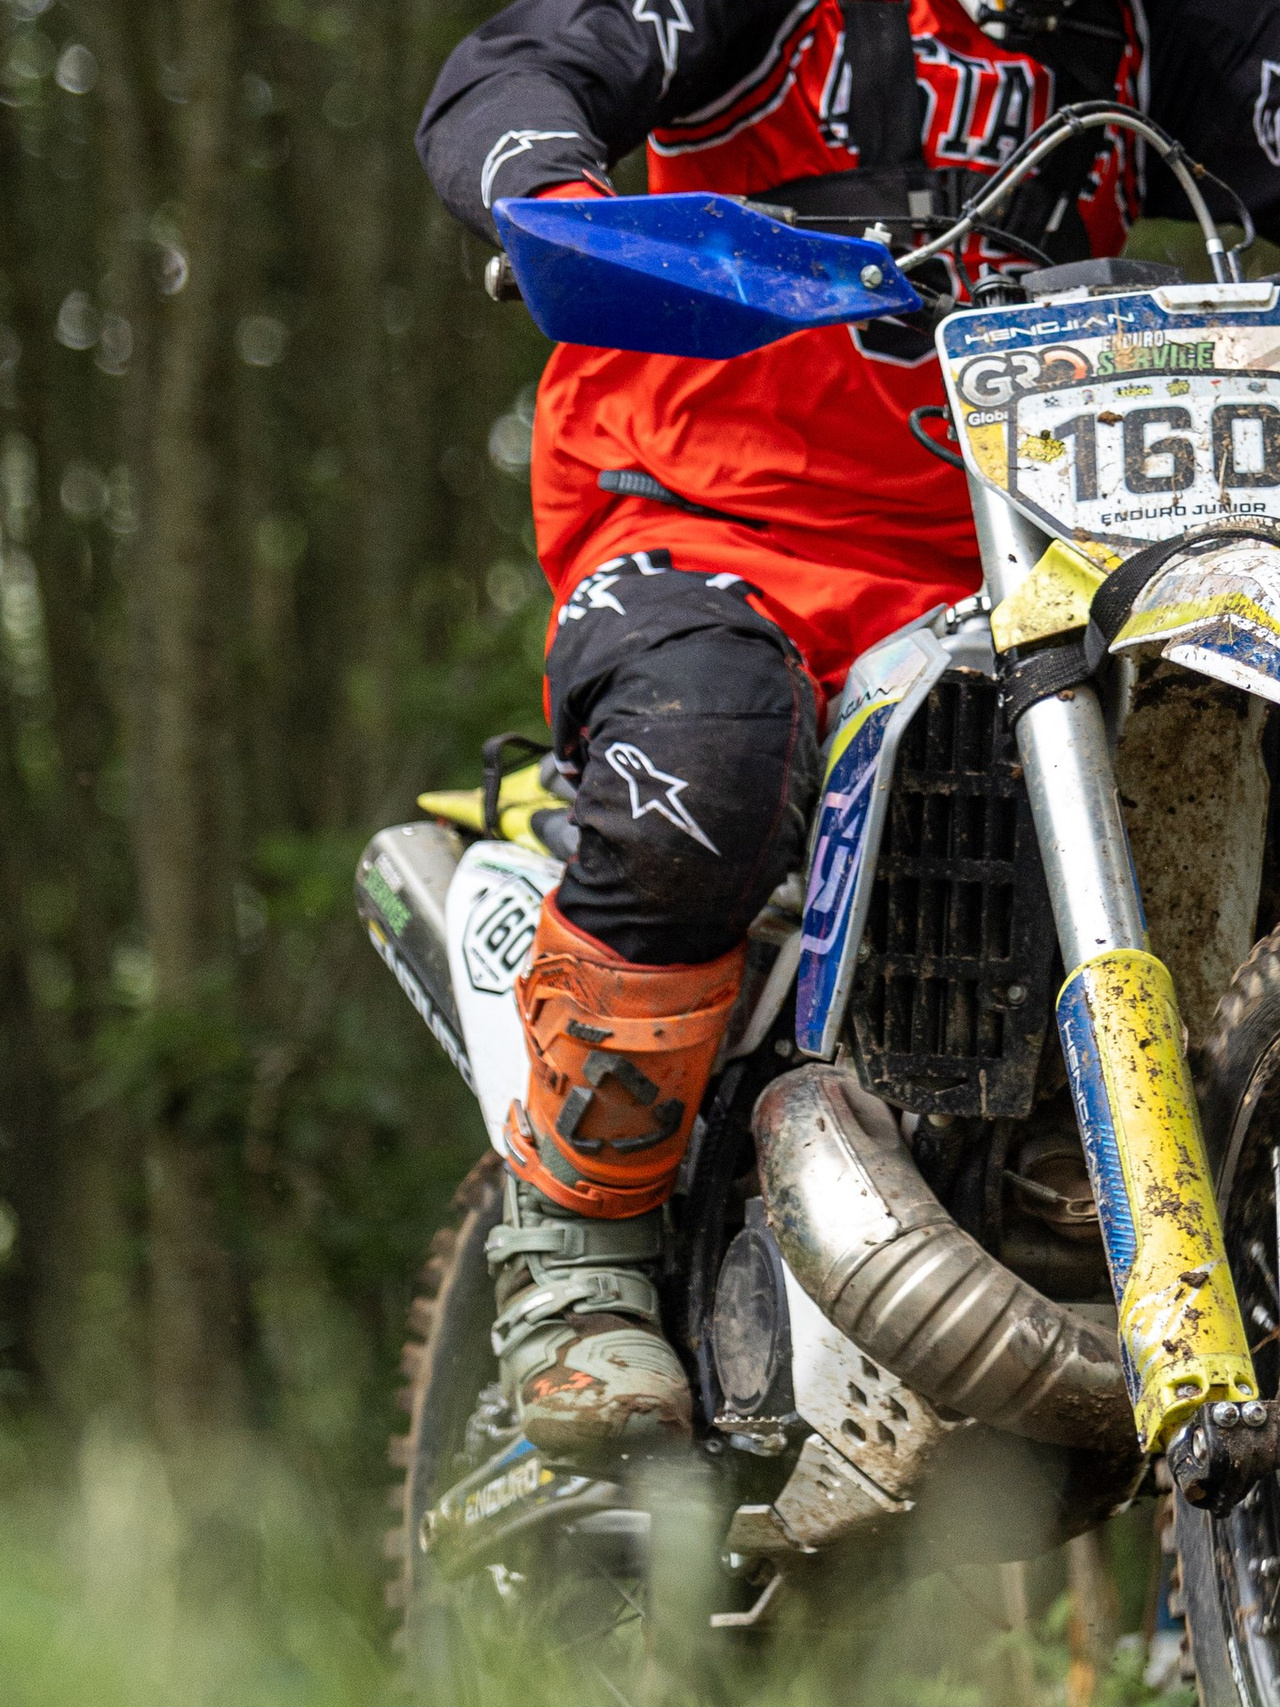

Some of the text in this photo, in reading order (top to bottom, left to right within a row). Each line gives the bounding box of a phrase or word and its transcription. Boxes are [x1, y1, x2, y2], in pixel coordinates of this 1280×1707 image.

[964, 311, 1135, 345] HENGJIAN
[1097, 341, 1216, 376] SRVICE
[1101, 505, 1187, 524] ENDURO
[476, 896, 538, 971] 160
